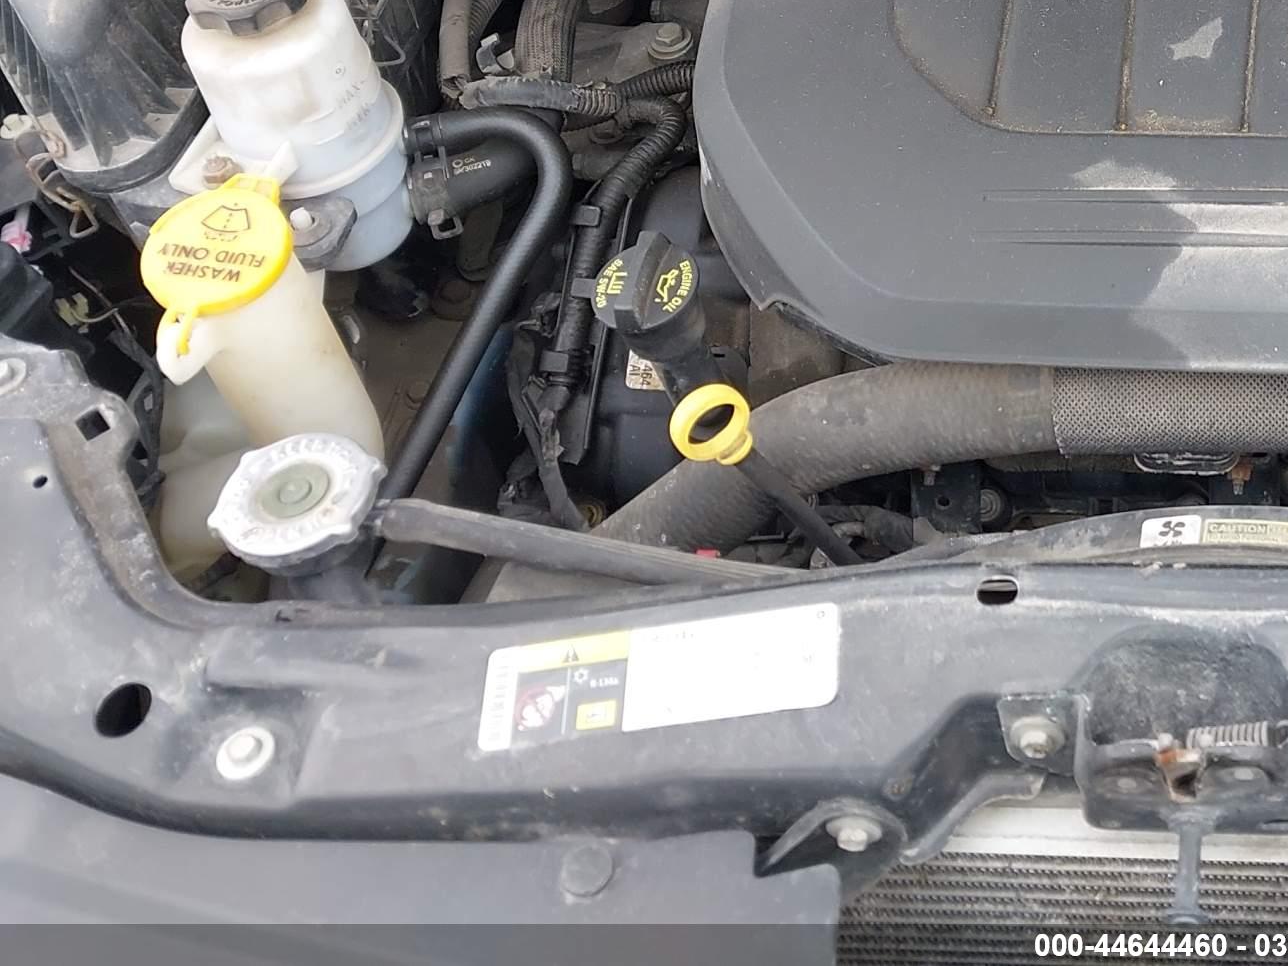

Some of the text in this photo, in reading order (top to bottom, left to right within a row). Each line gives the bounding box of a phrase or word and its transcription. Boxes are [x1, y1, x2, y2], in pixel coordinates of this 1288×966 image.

[158, 243, 266, 268] FLUID ONLY
[166, 261, 241, 282] WASHER
[595, 258, 624, 309] SAE 5W-20
[662, 260, 692, 313] ENGINE OIL
[1208, 523, 1266, 533] CAUTION
